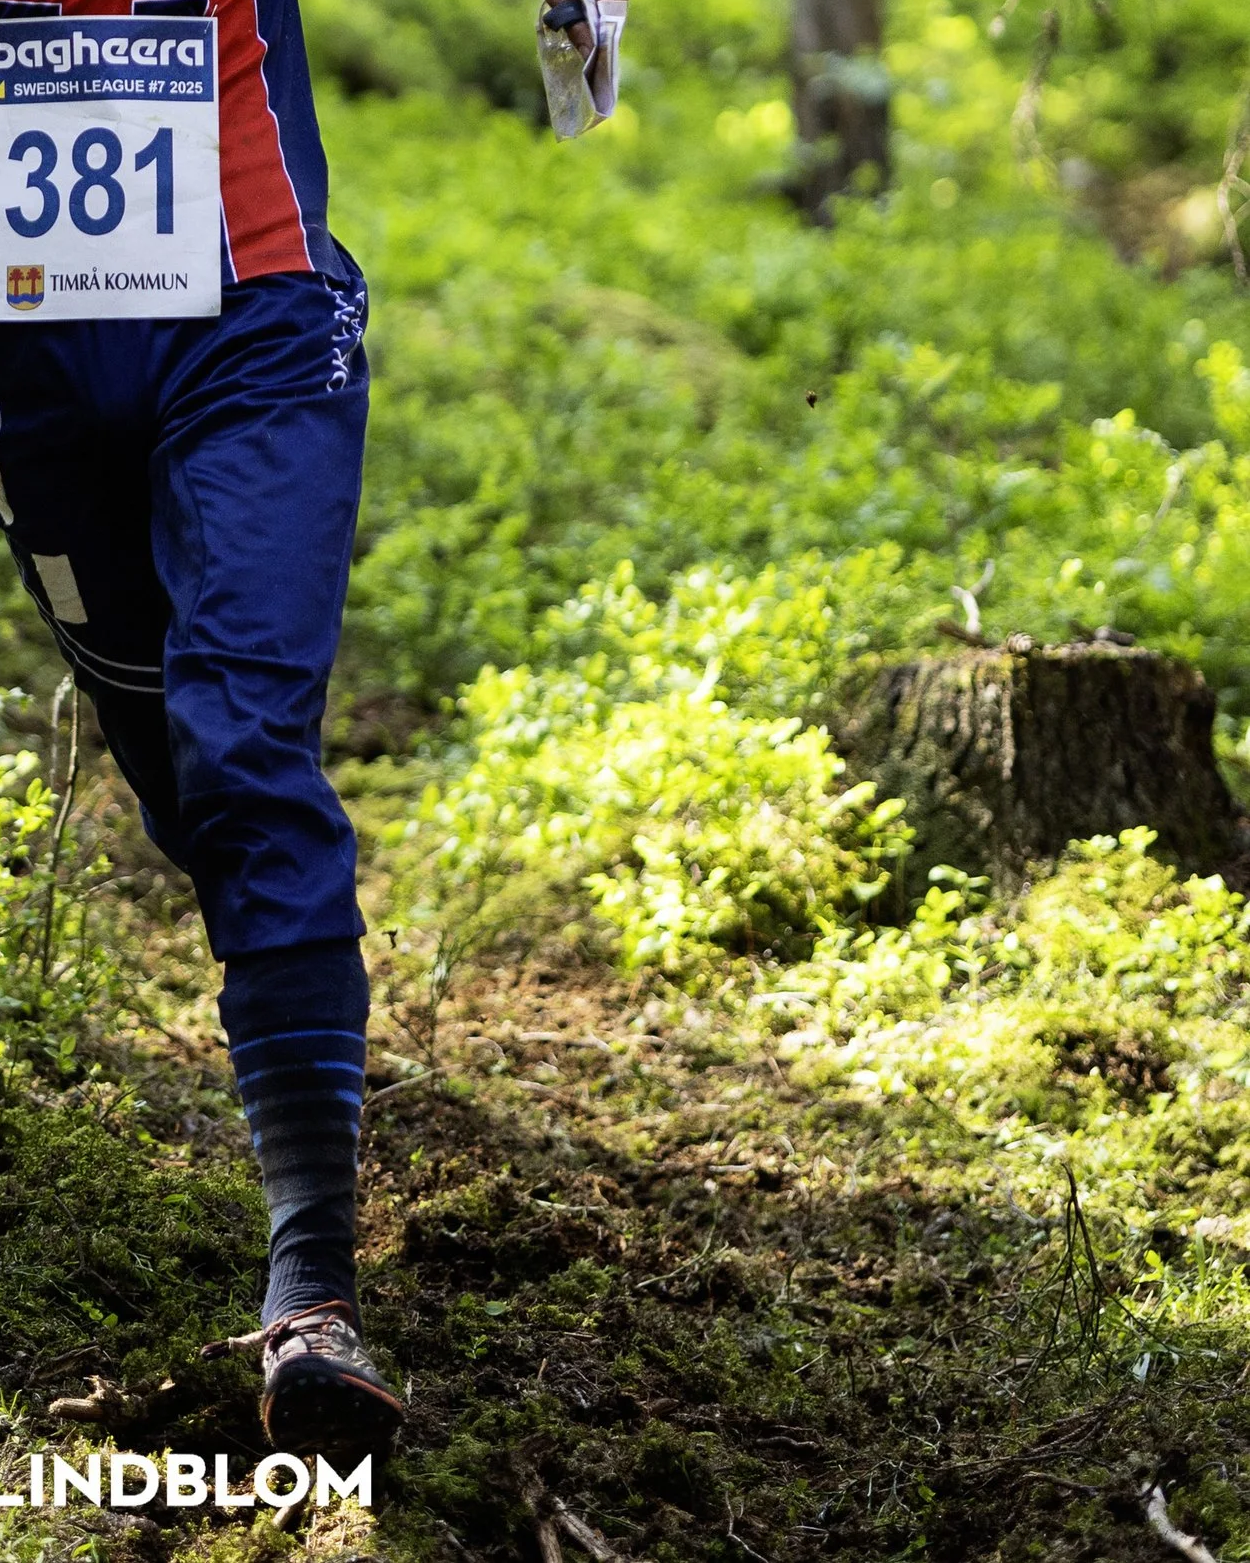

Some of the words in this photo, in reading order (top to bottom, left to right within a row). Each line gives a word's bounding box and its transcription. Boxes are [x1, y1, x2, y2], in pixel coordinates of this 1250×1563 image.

[13, 80, 80, 97] SWEDISH
[83, 78, 145, 94] LEAGUE
[148, 80, 166, 94] #7
[169, 80, 204, 94] 2025
[5, 126, 175, 239] 381
[50, 266, 101, 292] TIMRÅ
[104, 272, 189, 291] KOMMUN
